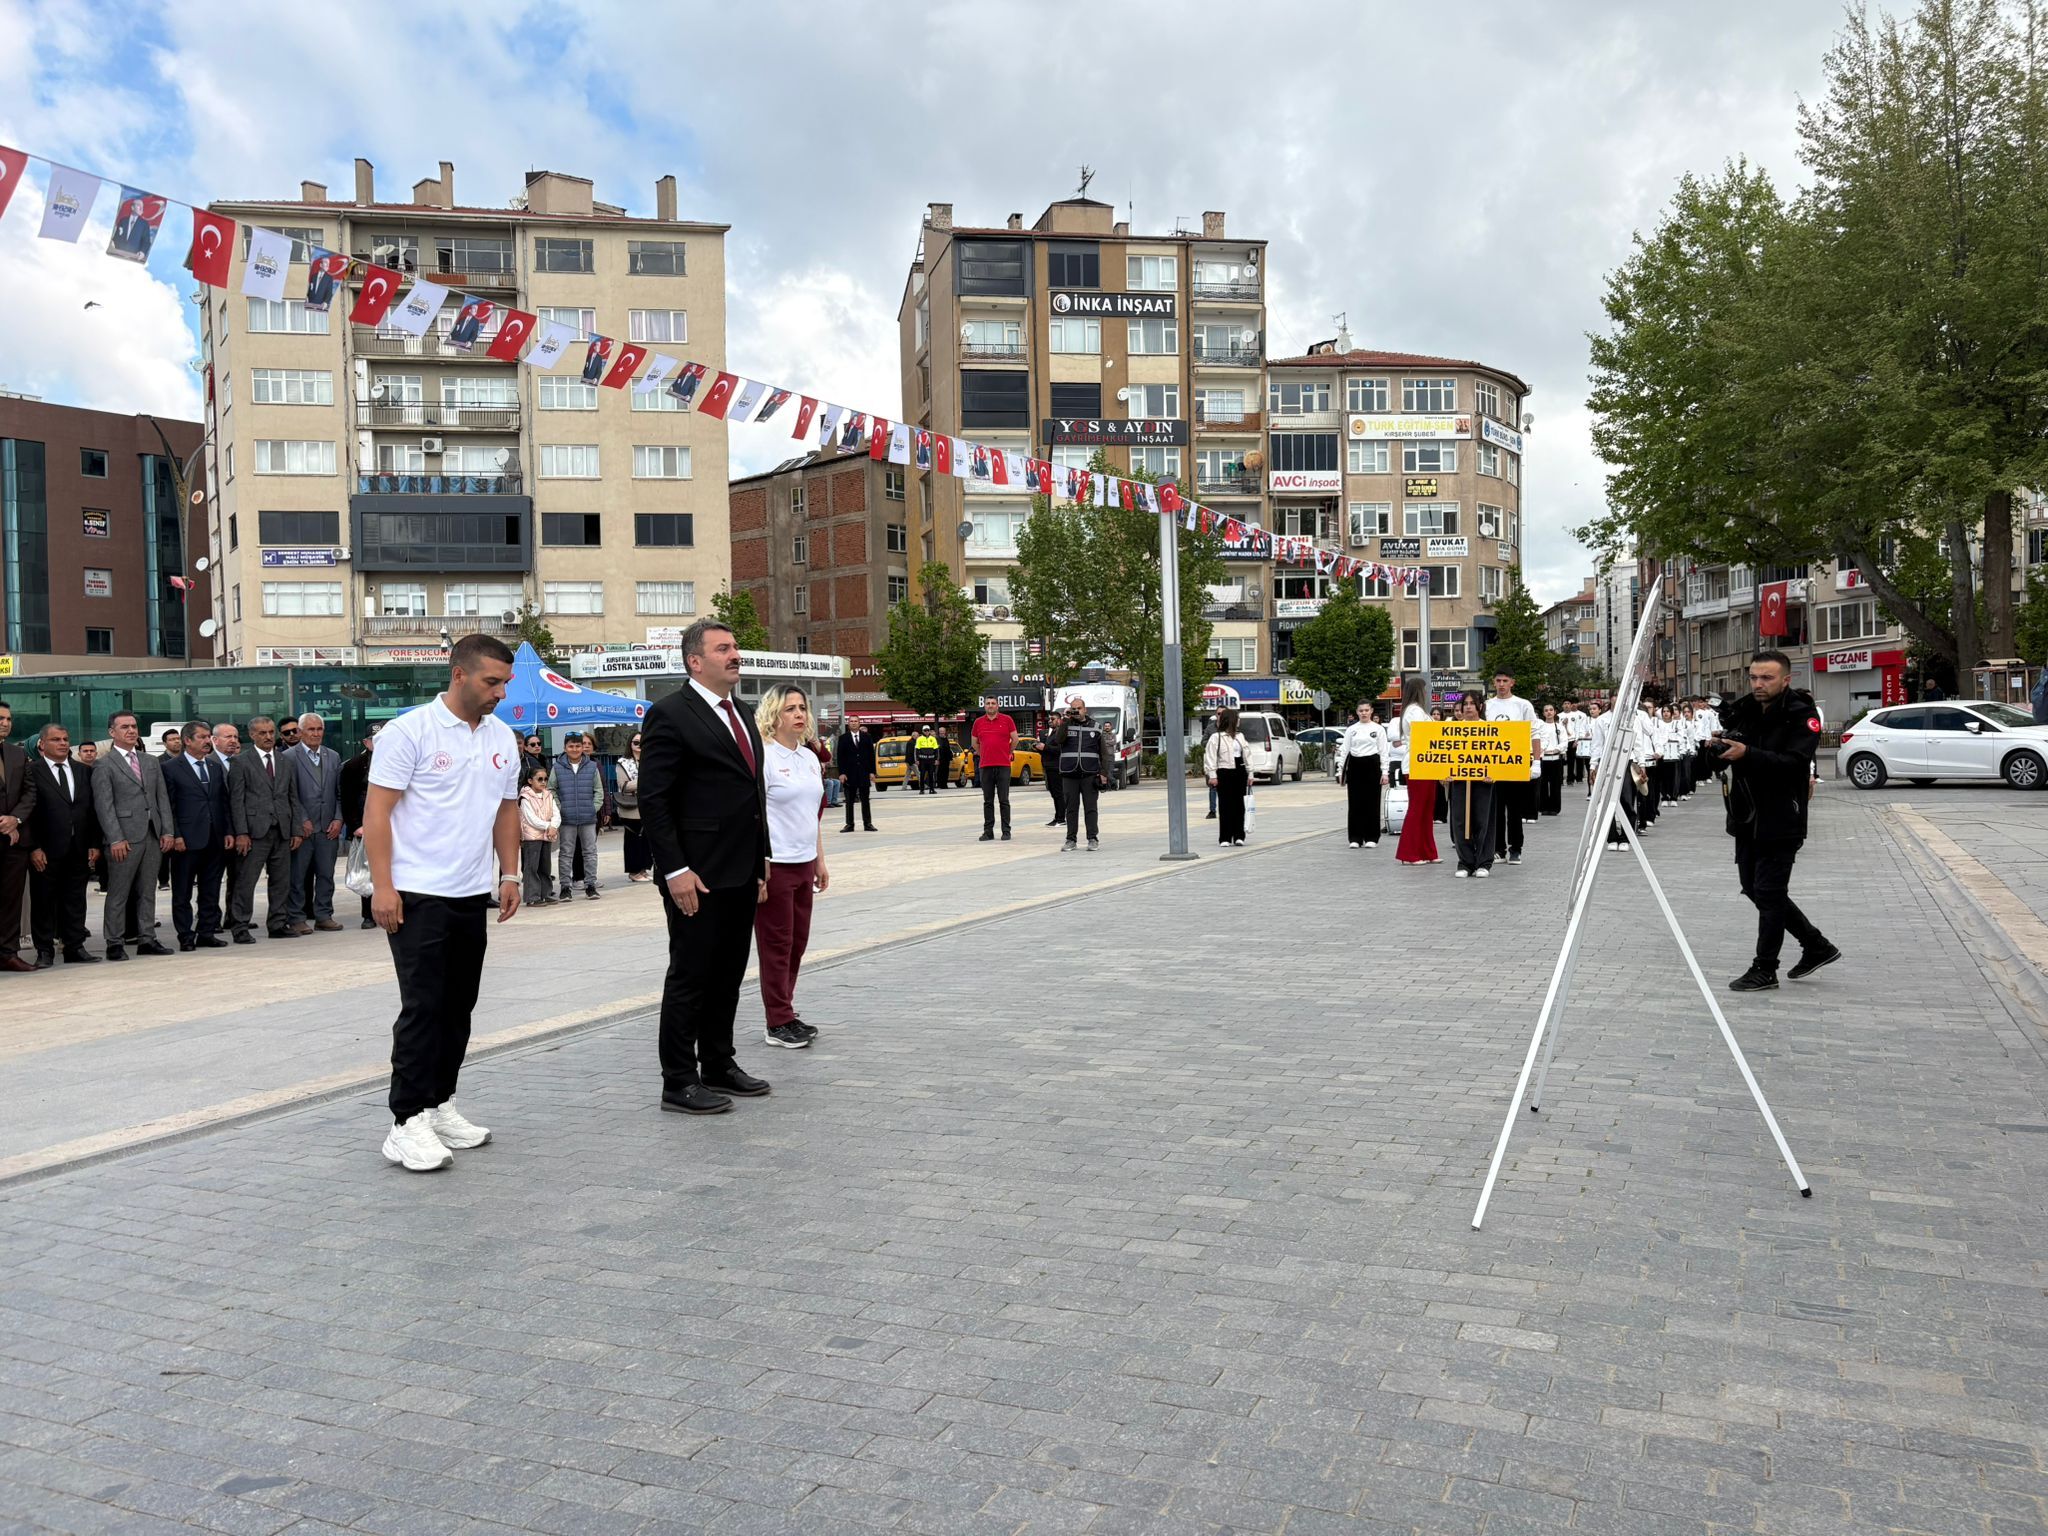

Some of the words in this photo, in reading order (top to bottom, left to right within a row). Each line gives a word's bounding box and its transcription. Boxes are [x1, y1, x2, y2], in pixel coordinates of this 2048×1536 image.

[1074, 293, 1112, 311] İNKA
[1117, 295, 1173, 315] İNŞAAT
[1060, 420, 1100, 433] YGS
[1107, 422, 1117, 433] &
[1124, 421, 1173, 434] AYDIN
[1368, 418, 1395, 431] TÜRK
[1137, 434, 1175, 444] İNŞAAT
[1382, 542, 1419, 550] AVUKAT
[1430, 538, 1465, 546] AVUKAT
[631, 654, 662, 662] BELEDİYESİ
[756, 657, 789, 669] BELEDİYESİ
[789, 660, 810, 670] LOSTRA
[811, 661, 831, 672] SALONU
[1829, 652, 1868, 664] ECZANE
[602, 662, 633, 672] LOSTRA
[635, 661, 666, 671] SALONU
[978, 695, 1026, 708] BGELLO
[1201, 694, 1238, 708] ŞEHİR
[567, 704, 591, 715] KIRŞEHİR
[1442, 724, 1499, 738] KIRŞEHİR
[1430, 740, 1468, 751] NEŞET
[1471, 740, 1511, 752] ERTAŞ
[1417, 751, 1455, 764] GÜZEL
[1458, 754, 1523, 765] SANATLAR
[1450, 765, 1488, 778] LİSESİ
